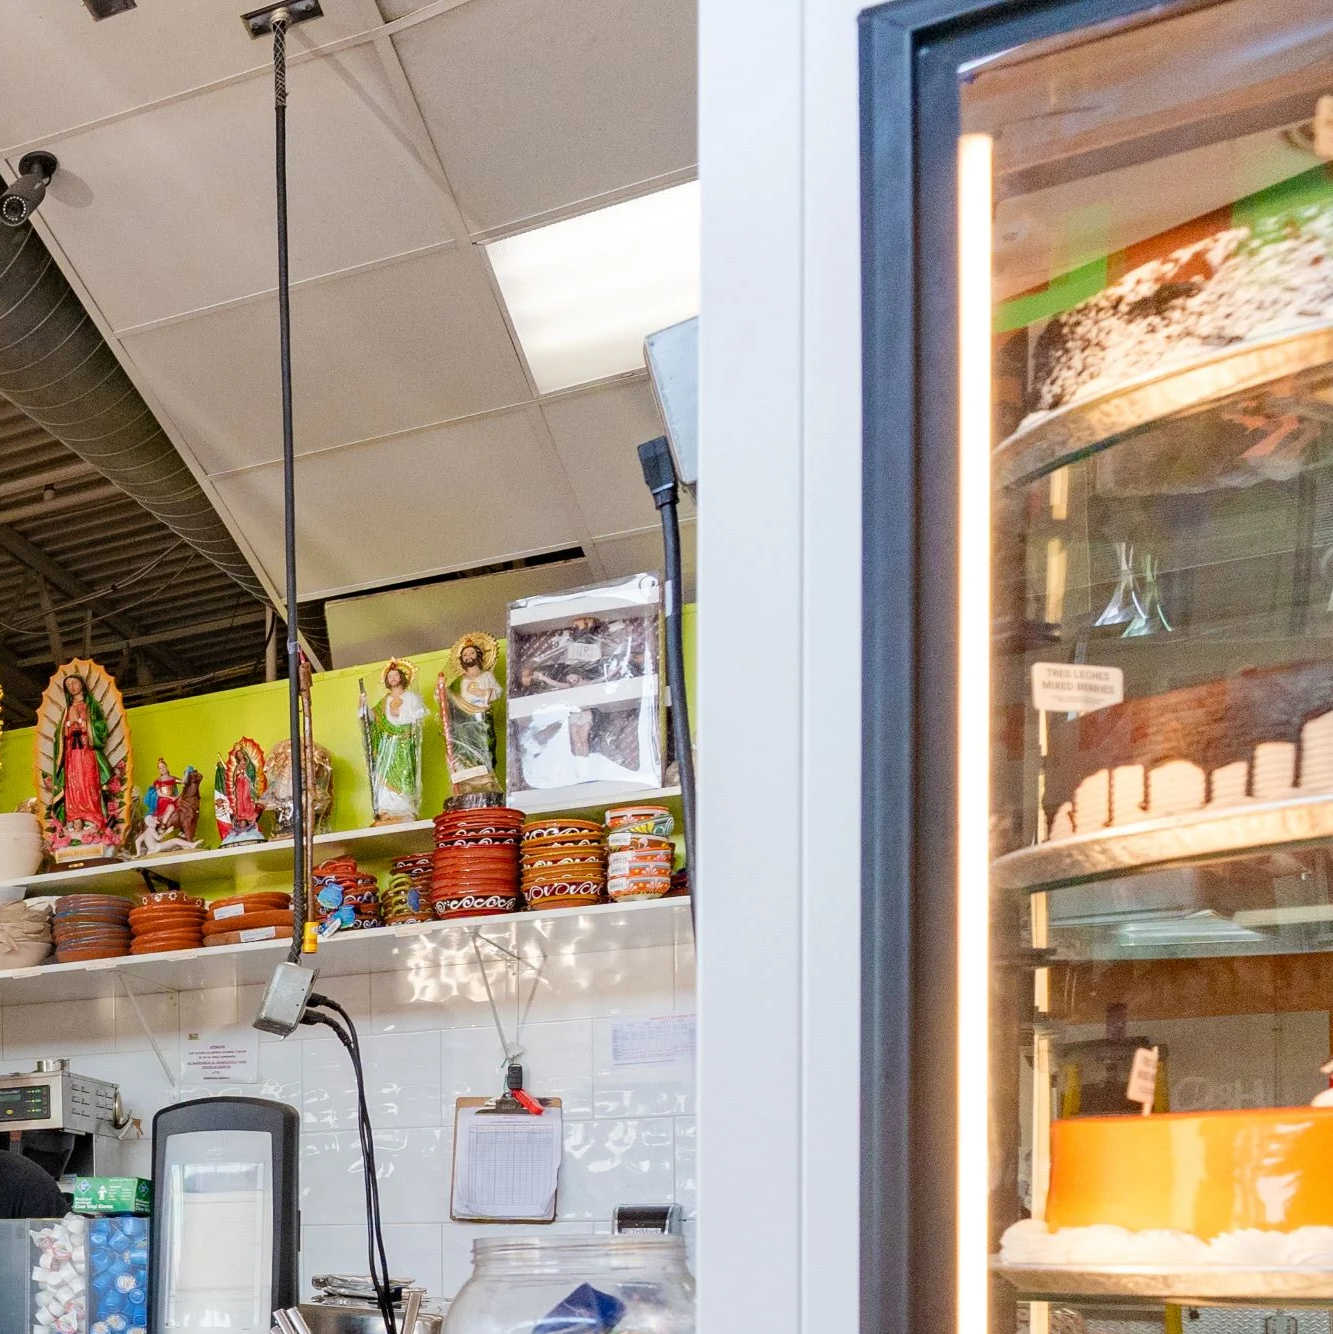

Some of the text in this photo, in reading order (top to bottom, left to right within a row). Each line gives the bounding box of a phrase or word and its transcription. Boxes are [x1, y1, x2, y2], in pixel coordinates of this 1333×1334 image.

[1045, 668, 1110, 681] TRES LECHES
[1042, 680, 1116, 694] MIXED BERRIES
